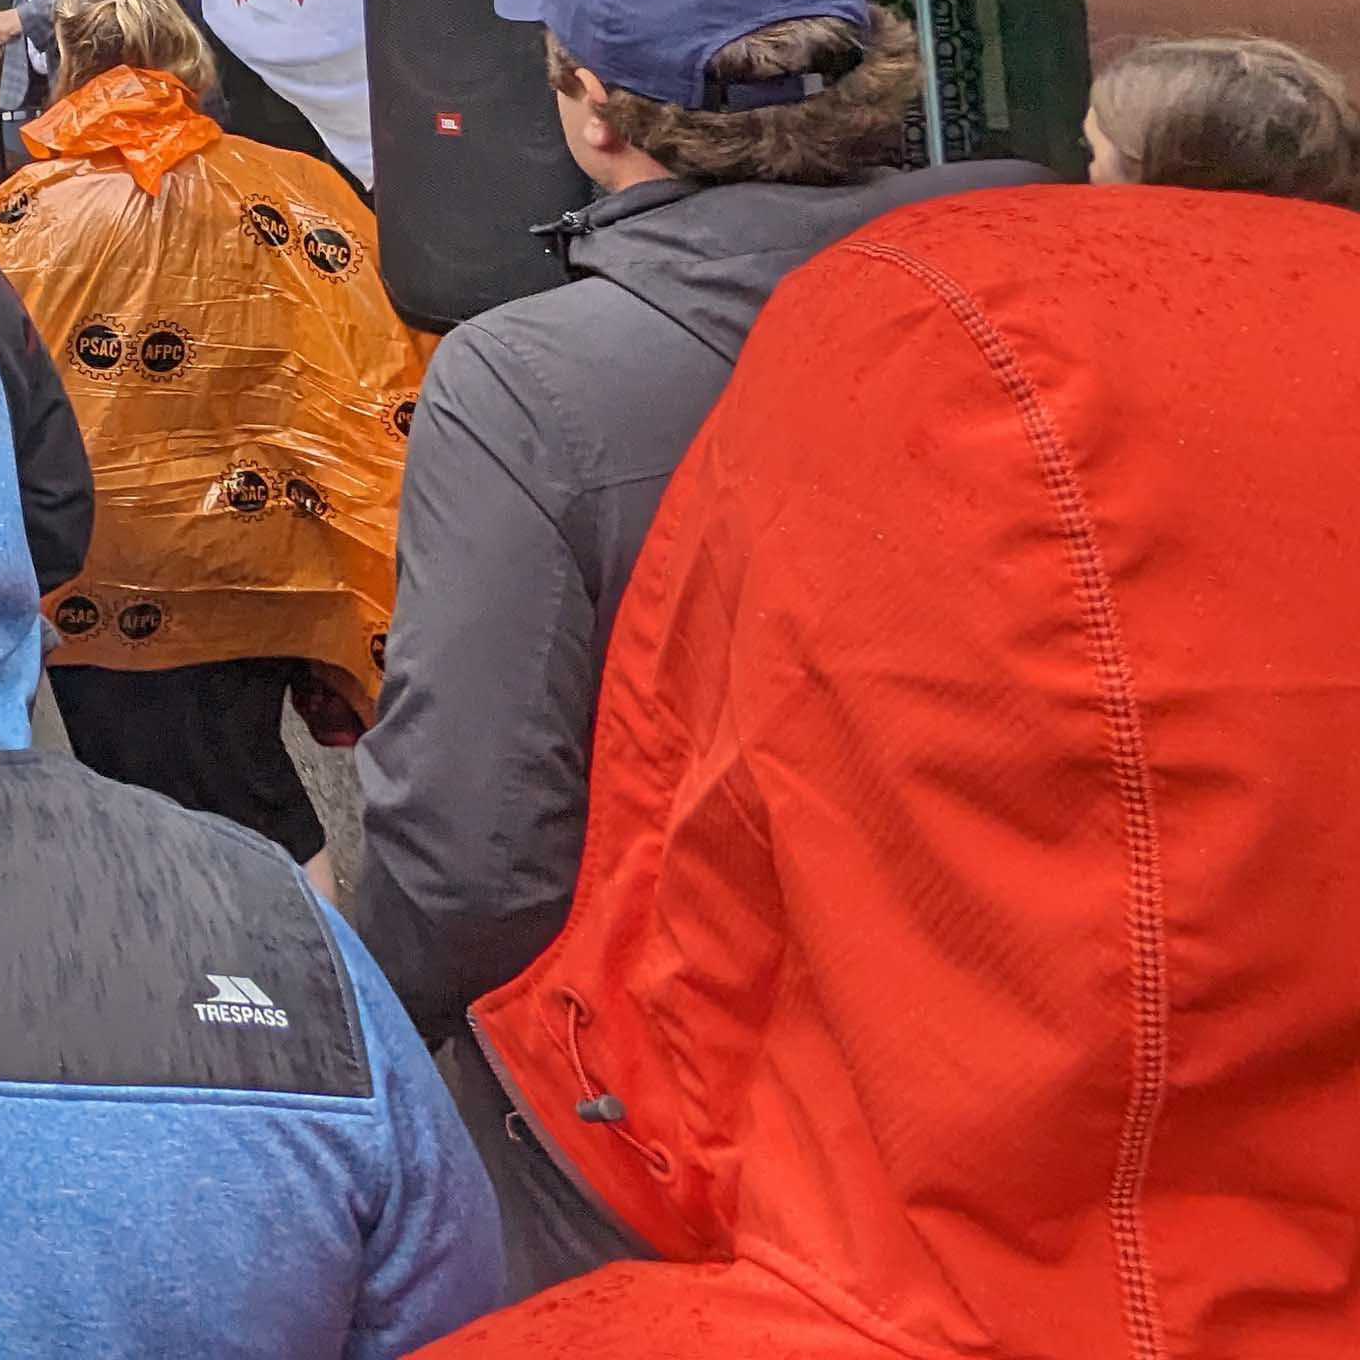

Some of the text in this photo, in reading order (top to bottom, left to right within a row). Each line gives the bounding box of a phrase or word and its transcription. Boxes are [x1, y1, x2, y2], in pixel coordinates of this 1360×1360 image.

[251, 211, 289, 239] PSAC
[307, 240, 350, 265] AFPC
[80, 339, 120, 360] PSAC
[144, 343, 181, 361] AFPC
[193, 1003, 289, 1028] TRESPASS
